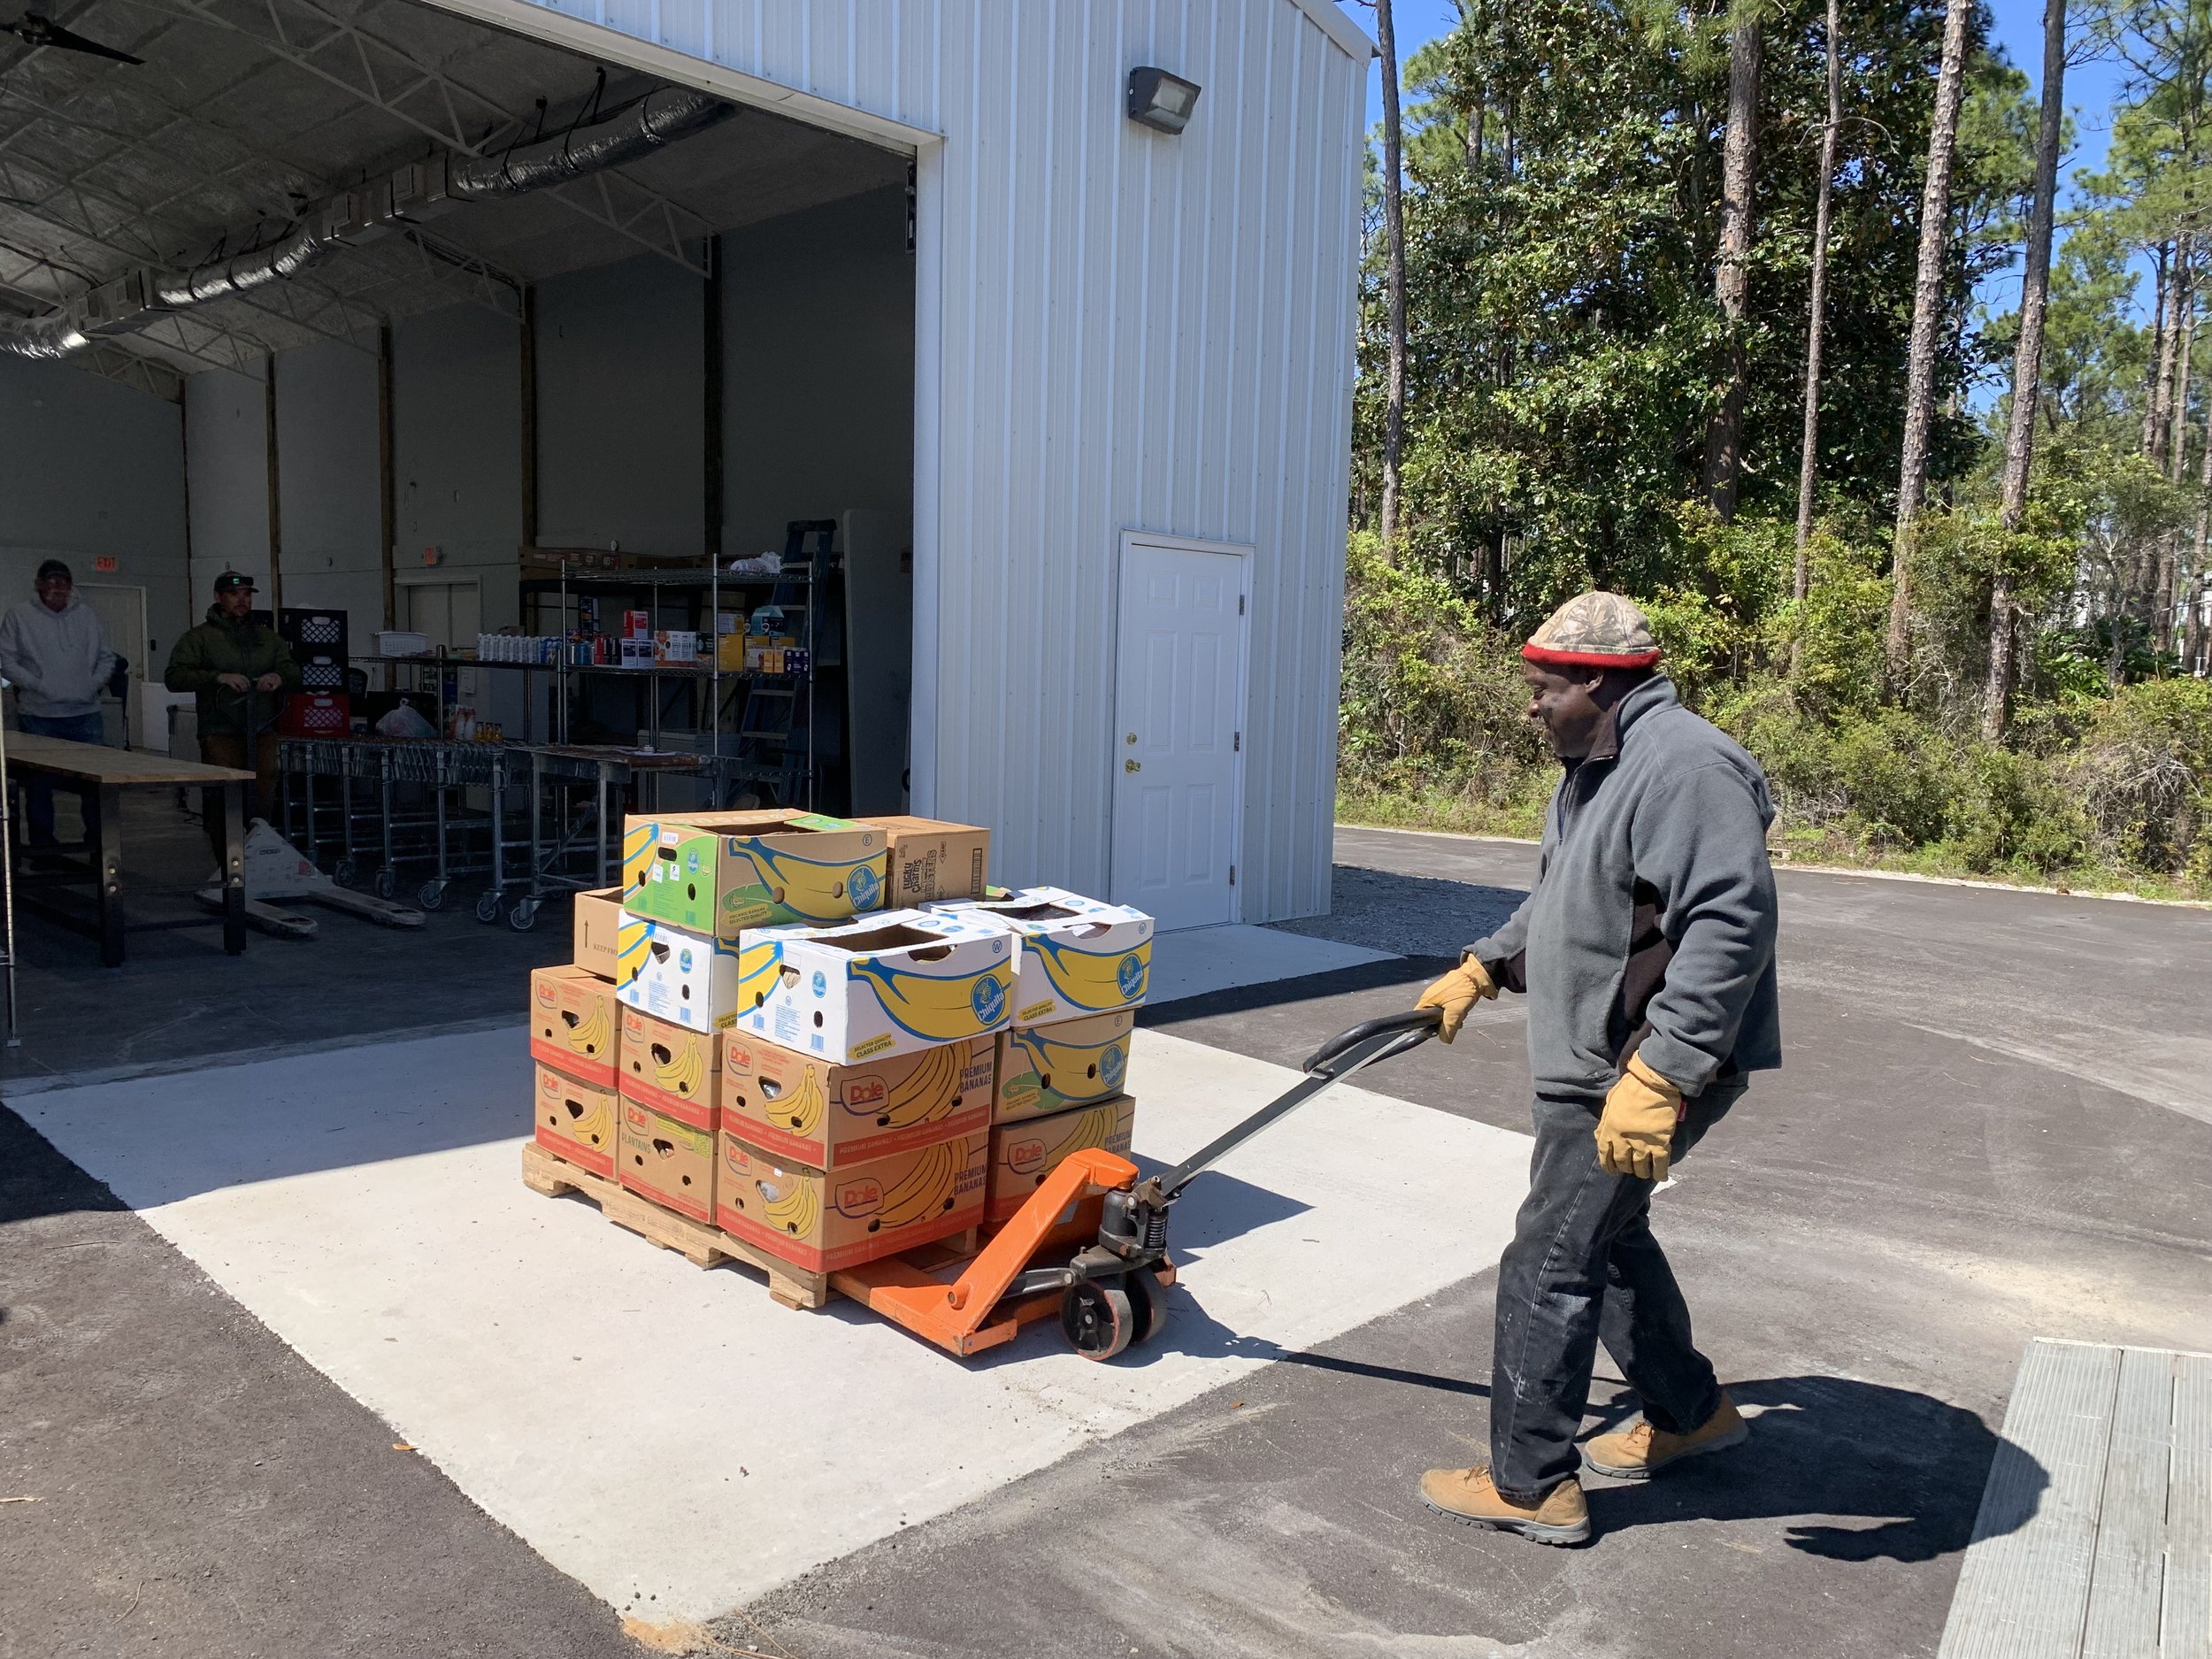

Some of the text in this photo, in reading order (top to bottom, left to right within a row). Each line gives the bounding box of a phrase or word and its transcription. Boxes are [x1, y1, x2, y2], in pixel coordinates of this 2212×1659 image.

[97, 557, 116, 568] EXIT
[903, 863, 914, 890] Lucky
[911, 859, 922, 894] Charms
[852, 881, 879, 908] Chiquita
[728, 910, 767, 925] SELECTED QUALITY
[593, 943, 607, 953] KEEP
[539, 983, 556, 999] Dole
[1120, 969, 1144, 995] Chiquita
[978, 990, 1005, 1022] Chiquita
[1022, 1001, 1052, 1016] SELECTED QUALITY
[1024, 1006, 1053, 1021] CLASS EXTRA
[626, 1014, 642, 1031] Dole
[854, 1033, 891, 1052] SELECTED QUALITY
[856, 1040, 892, 1058] CLASS EXTRA
[730, 1046, 751, 1065] Dole
[959, 1061, 992, 1079] PREMIUM
[1103, 1062, 1125, 1082] Chiquita
[542, 1072, 559, 1088] Dole
[959, 1073, 992, 1094] BANANAS
[849, 1081, 884, 1102] Dole
[627, 1106, 646, 1125] Dole
[621, 1132, 651, 1155] PLANTAINS
[1104, 1129, 1132, 1145] PREMIUM
[728, 1145, 749, 1166] Dole
[840, 1142, 867, 1155] PREMIUM
[1015, 1143, 1042, 1162] Dole
[954, 1166, 987, 1183] PREMIUM
[954, 1175, 987, 1195] BANANAS
[844, 1185, 879, 1205] Dole
